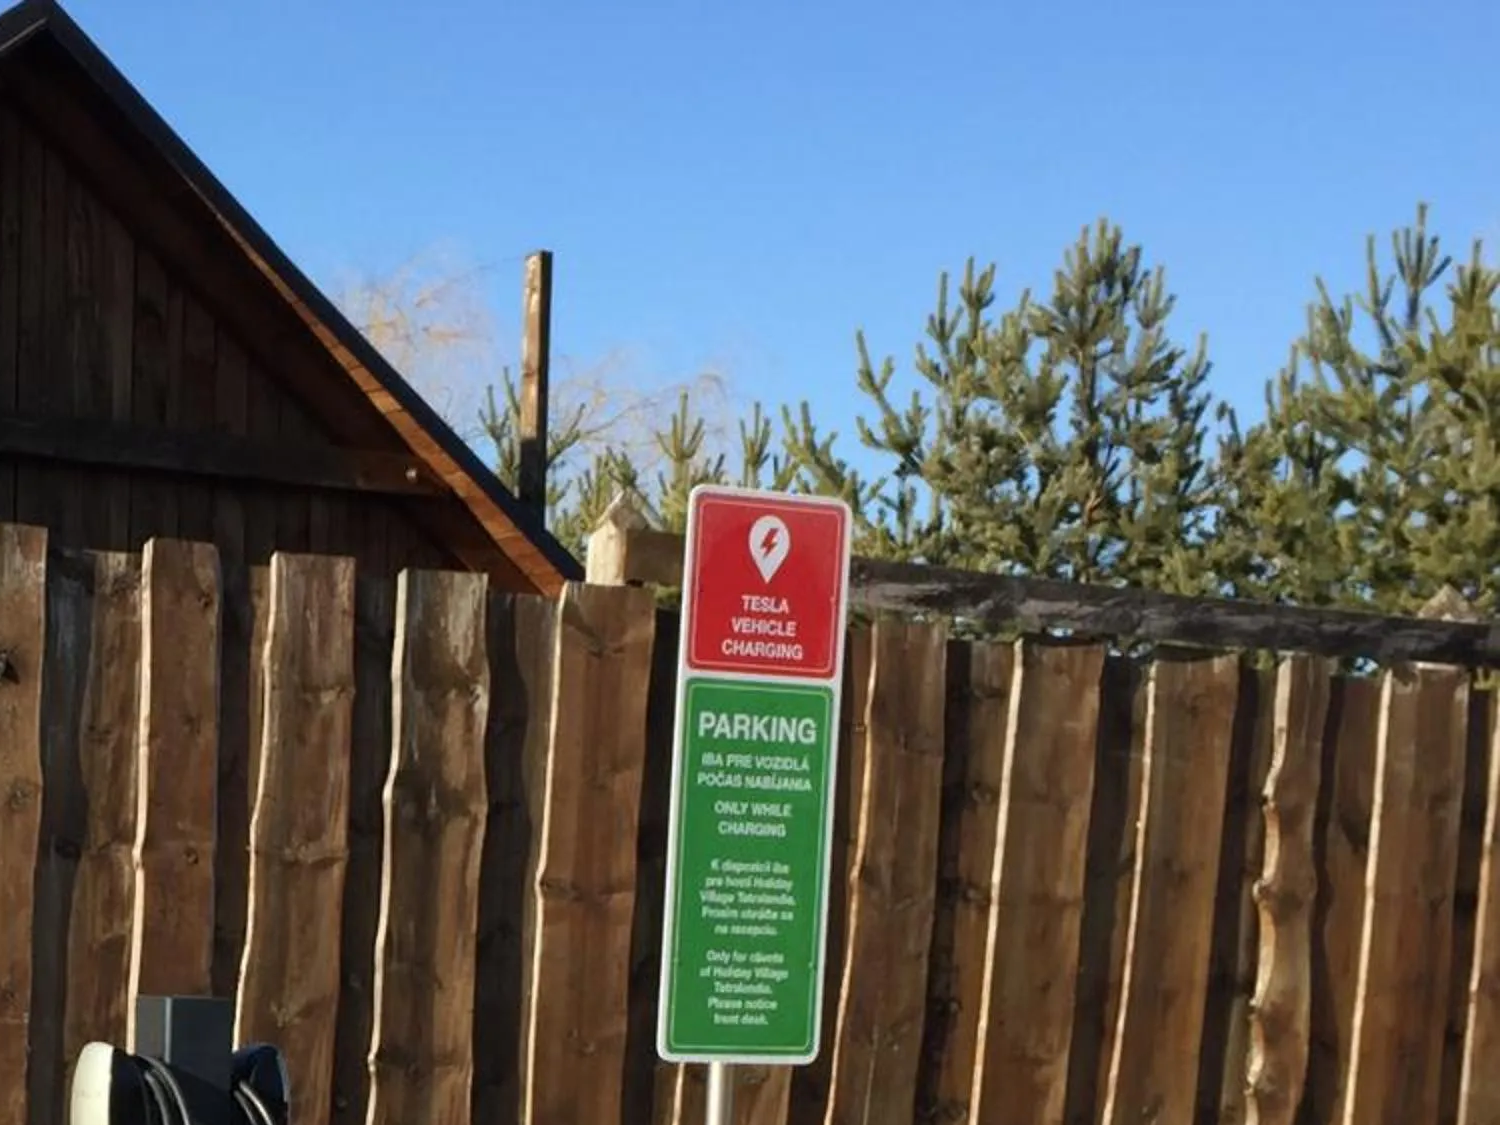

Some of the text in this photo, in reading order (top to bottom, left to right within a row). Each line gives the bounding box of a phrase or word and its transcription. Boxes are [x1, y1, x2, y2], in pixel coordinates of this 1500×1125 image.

[742, 595, 789, 613] TESLA
[732, 617, 797, 637] VEHICLE
[721, 639, 803, 660] CHARGING
[699, 711, 817, 744] PARKING
[702, 752, 809, 771] IBA PRE VOZIDLÁ
[714, 801, 792, 817] ONLY WHILE
[718, 820, 786, 837] CHARGING
